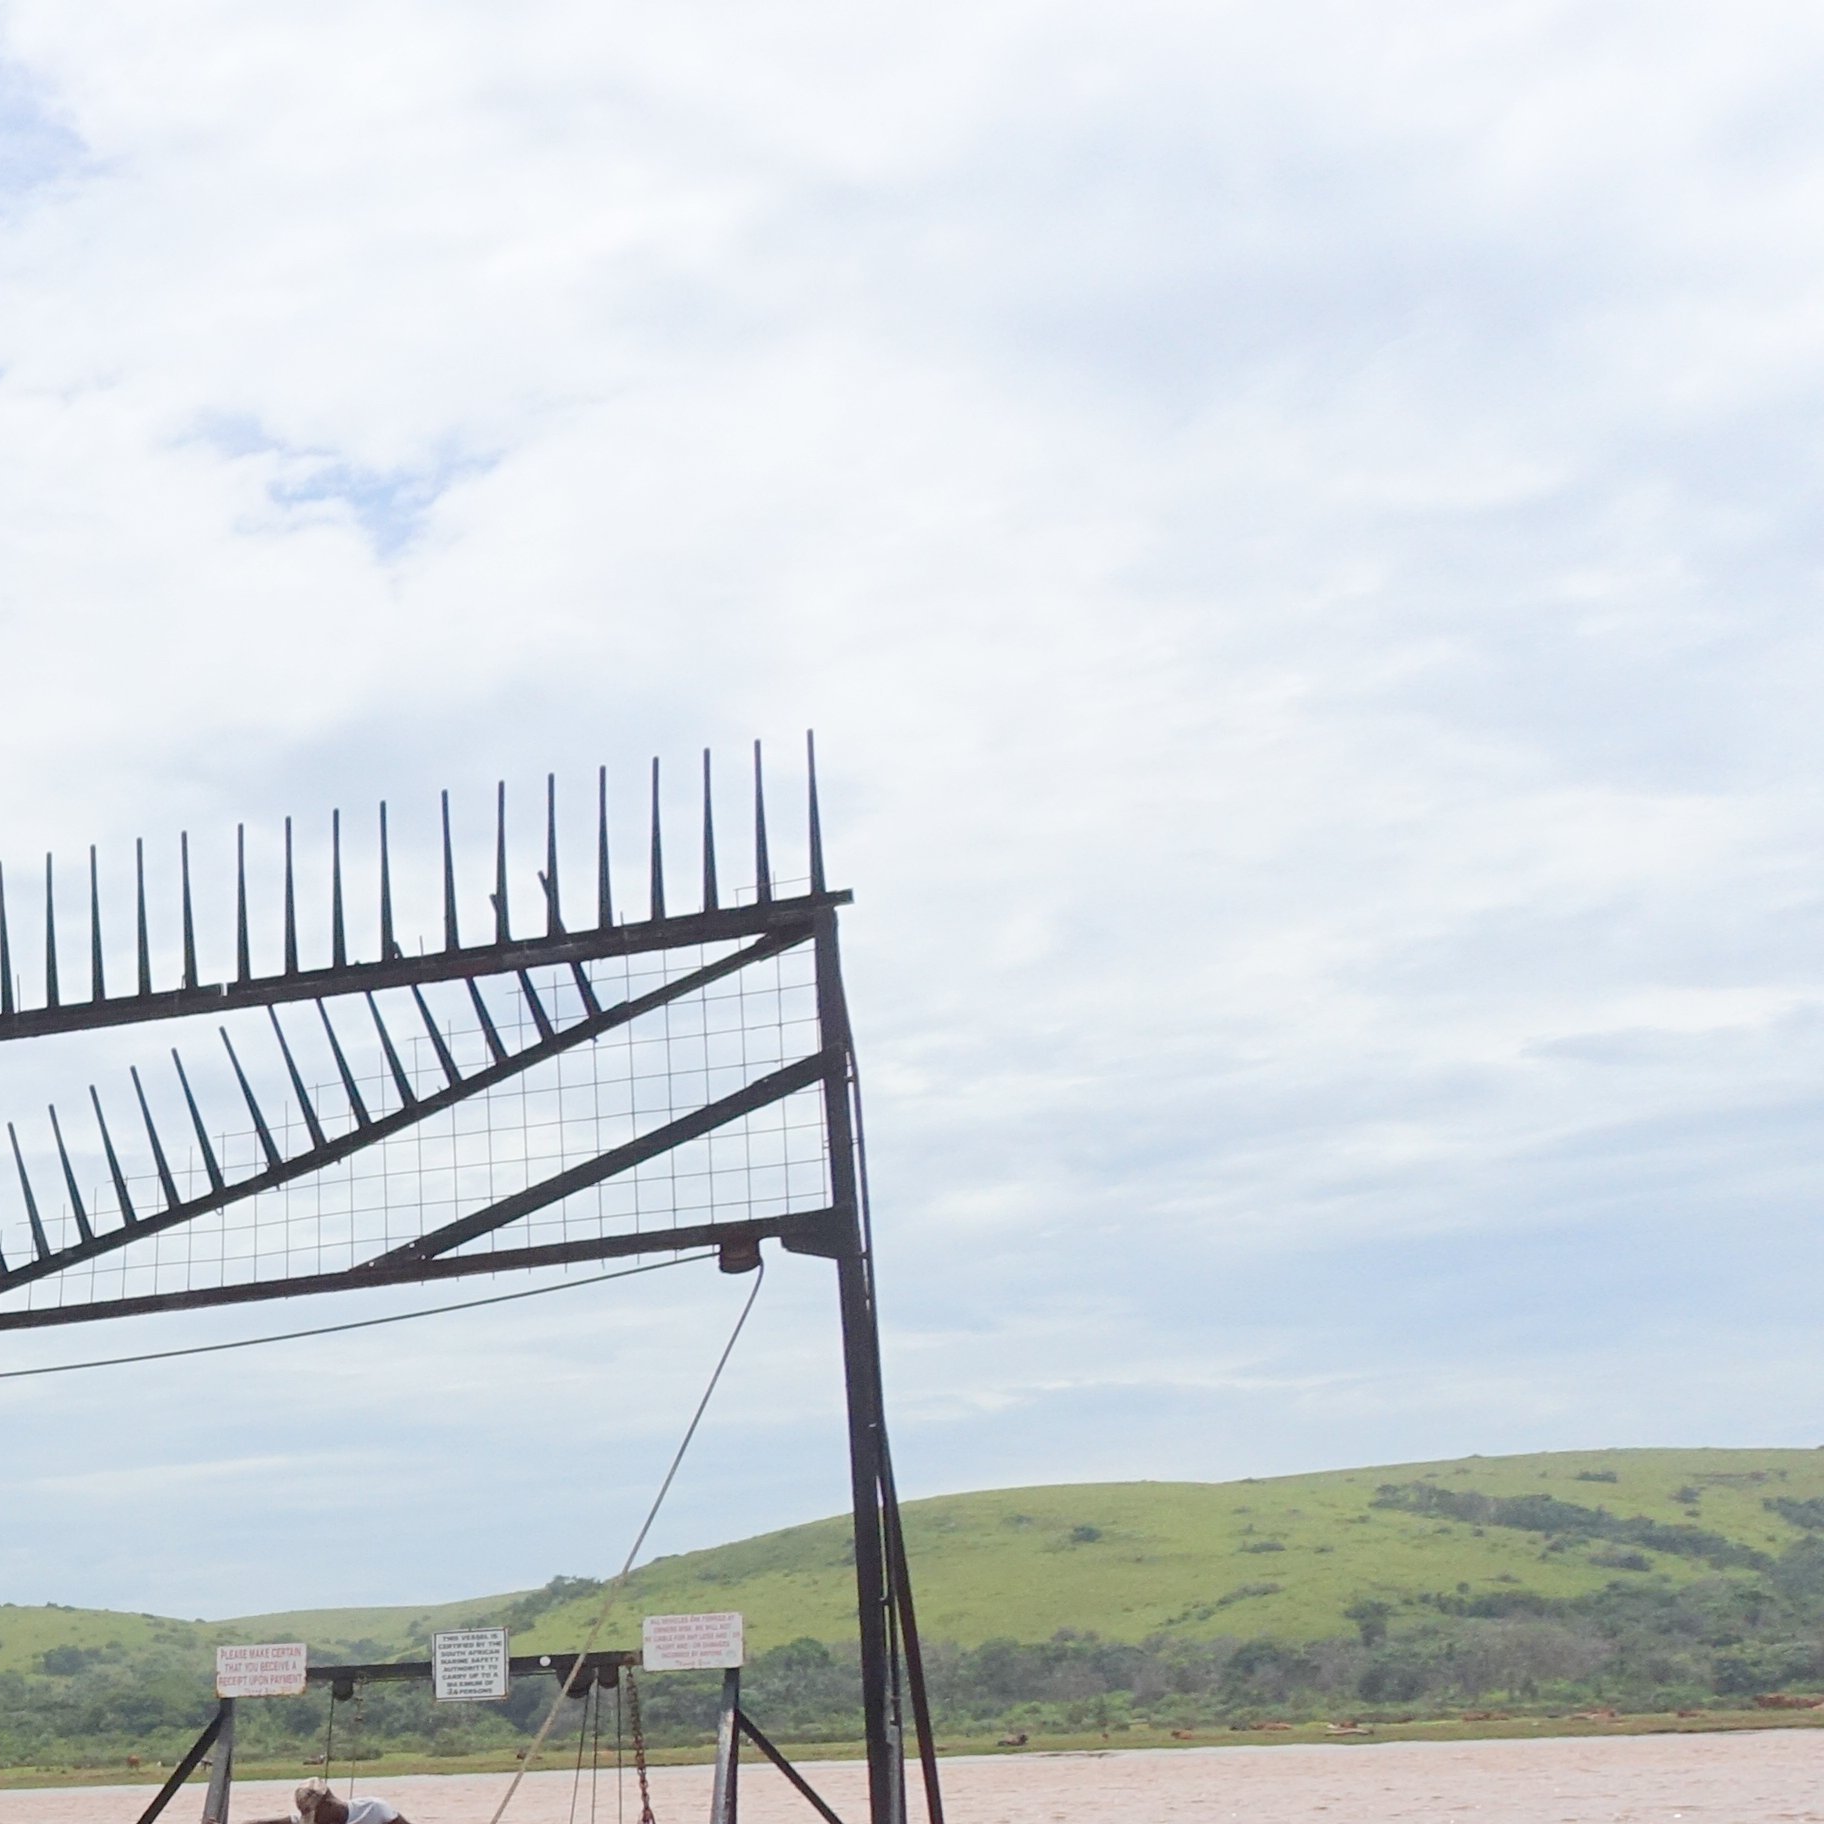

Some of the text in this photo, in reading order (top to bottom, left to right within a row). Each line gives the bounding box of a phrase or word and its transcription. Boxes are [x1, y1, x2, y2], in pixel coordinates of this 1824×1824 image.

[438, 1642, 474, 1650] CERTIFIED
[220, 1647, 302, 1659] PLEASE MAKE CERTAIN
[225, 1660, 297, 1672] THAT YOU RECEIVE A
[218, 1673, 303, 1686] RECEIPT UPON PAYMENT
